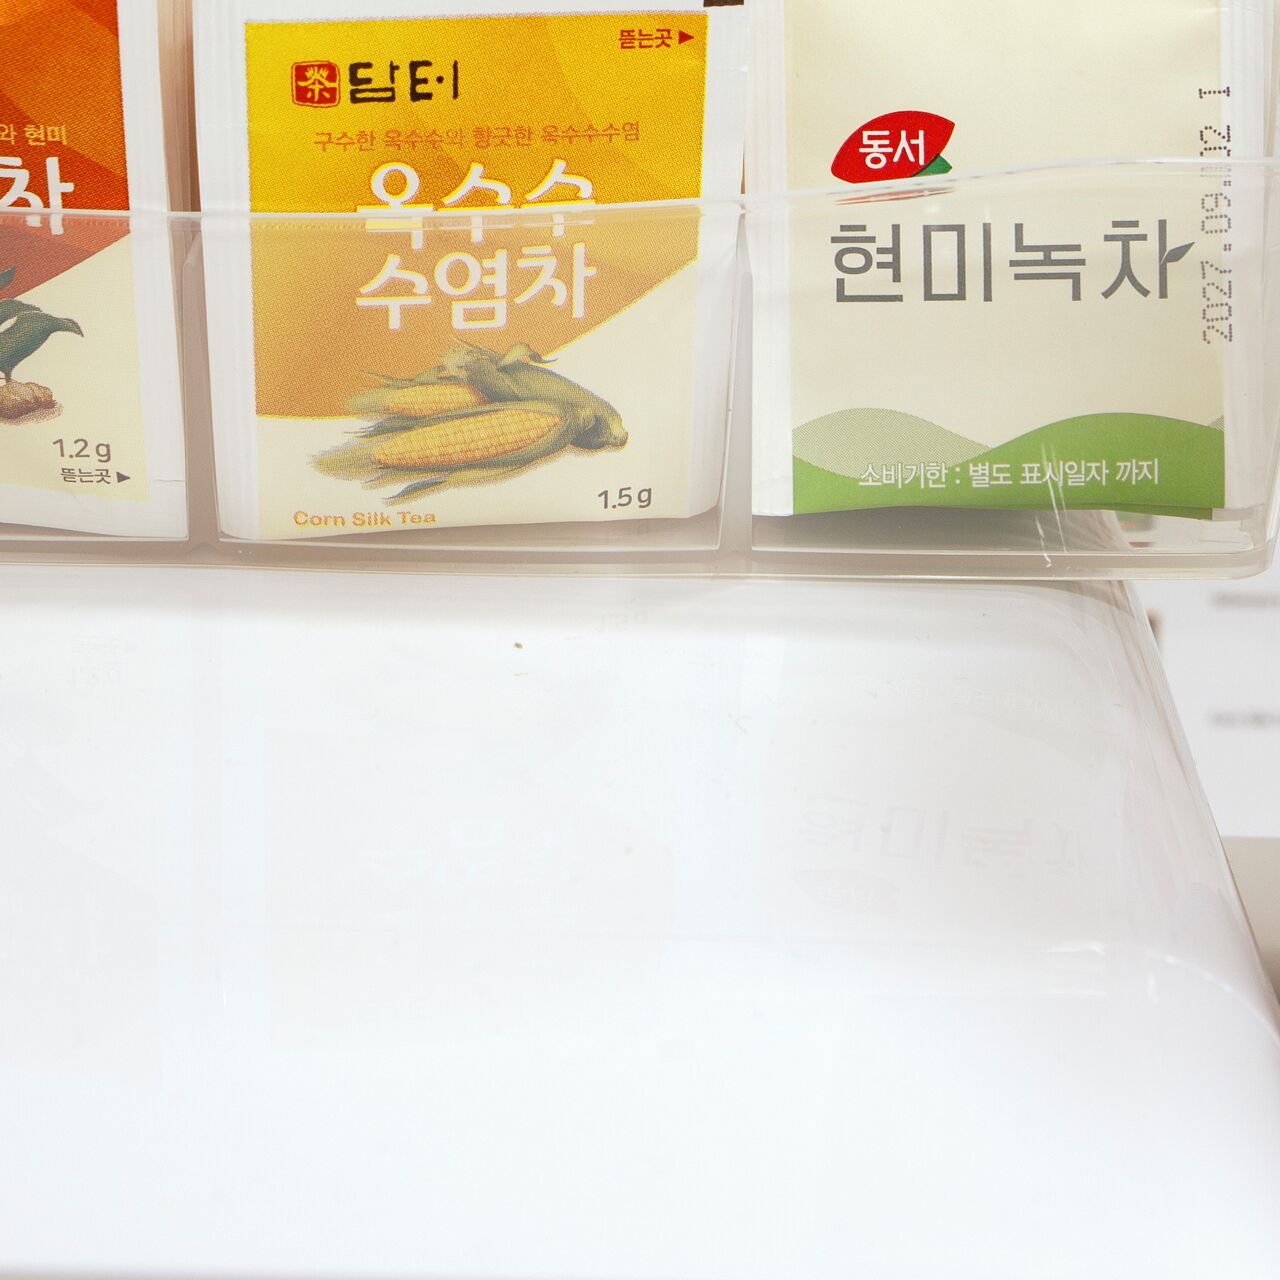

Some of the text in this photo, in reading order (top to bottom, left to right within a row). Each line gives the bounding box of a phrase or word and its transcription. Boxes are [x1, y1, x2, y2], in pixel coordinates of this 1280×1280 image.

[619, 28, 674, 50] 뜯는곳
[348, 59, 459, 104] 담터
[24, 124, 68, 146] 현미
[313, 129, 376, 153] 구수한
[472, 124, 534, 149] 향긋한
[541, 120, 641, 145] 옥수수수염
[858, 129, 926, 168] 동서
[830, 218, 1196, 303] 현미녹차
[355, 241, 597, 331] 수염차
[60, 467, 111, 484] 뜯는곳
[858, 461, 948, 489] 소비기한
[969, 462, 1013, 489] 별도
[1020, 459, 1109, 487] 표시일자
[1117, 458, 1160, 485] 까지
[292, 511, 437, 528] Corn Silk Tea
